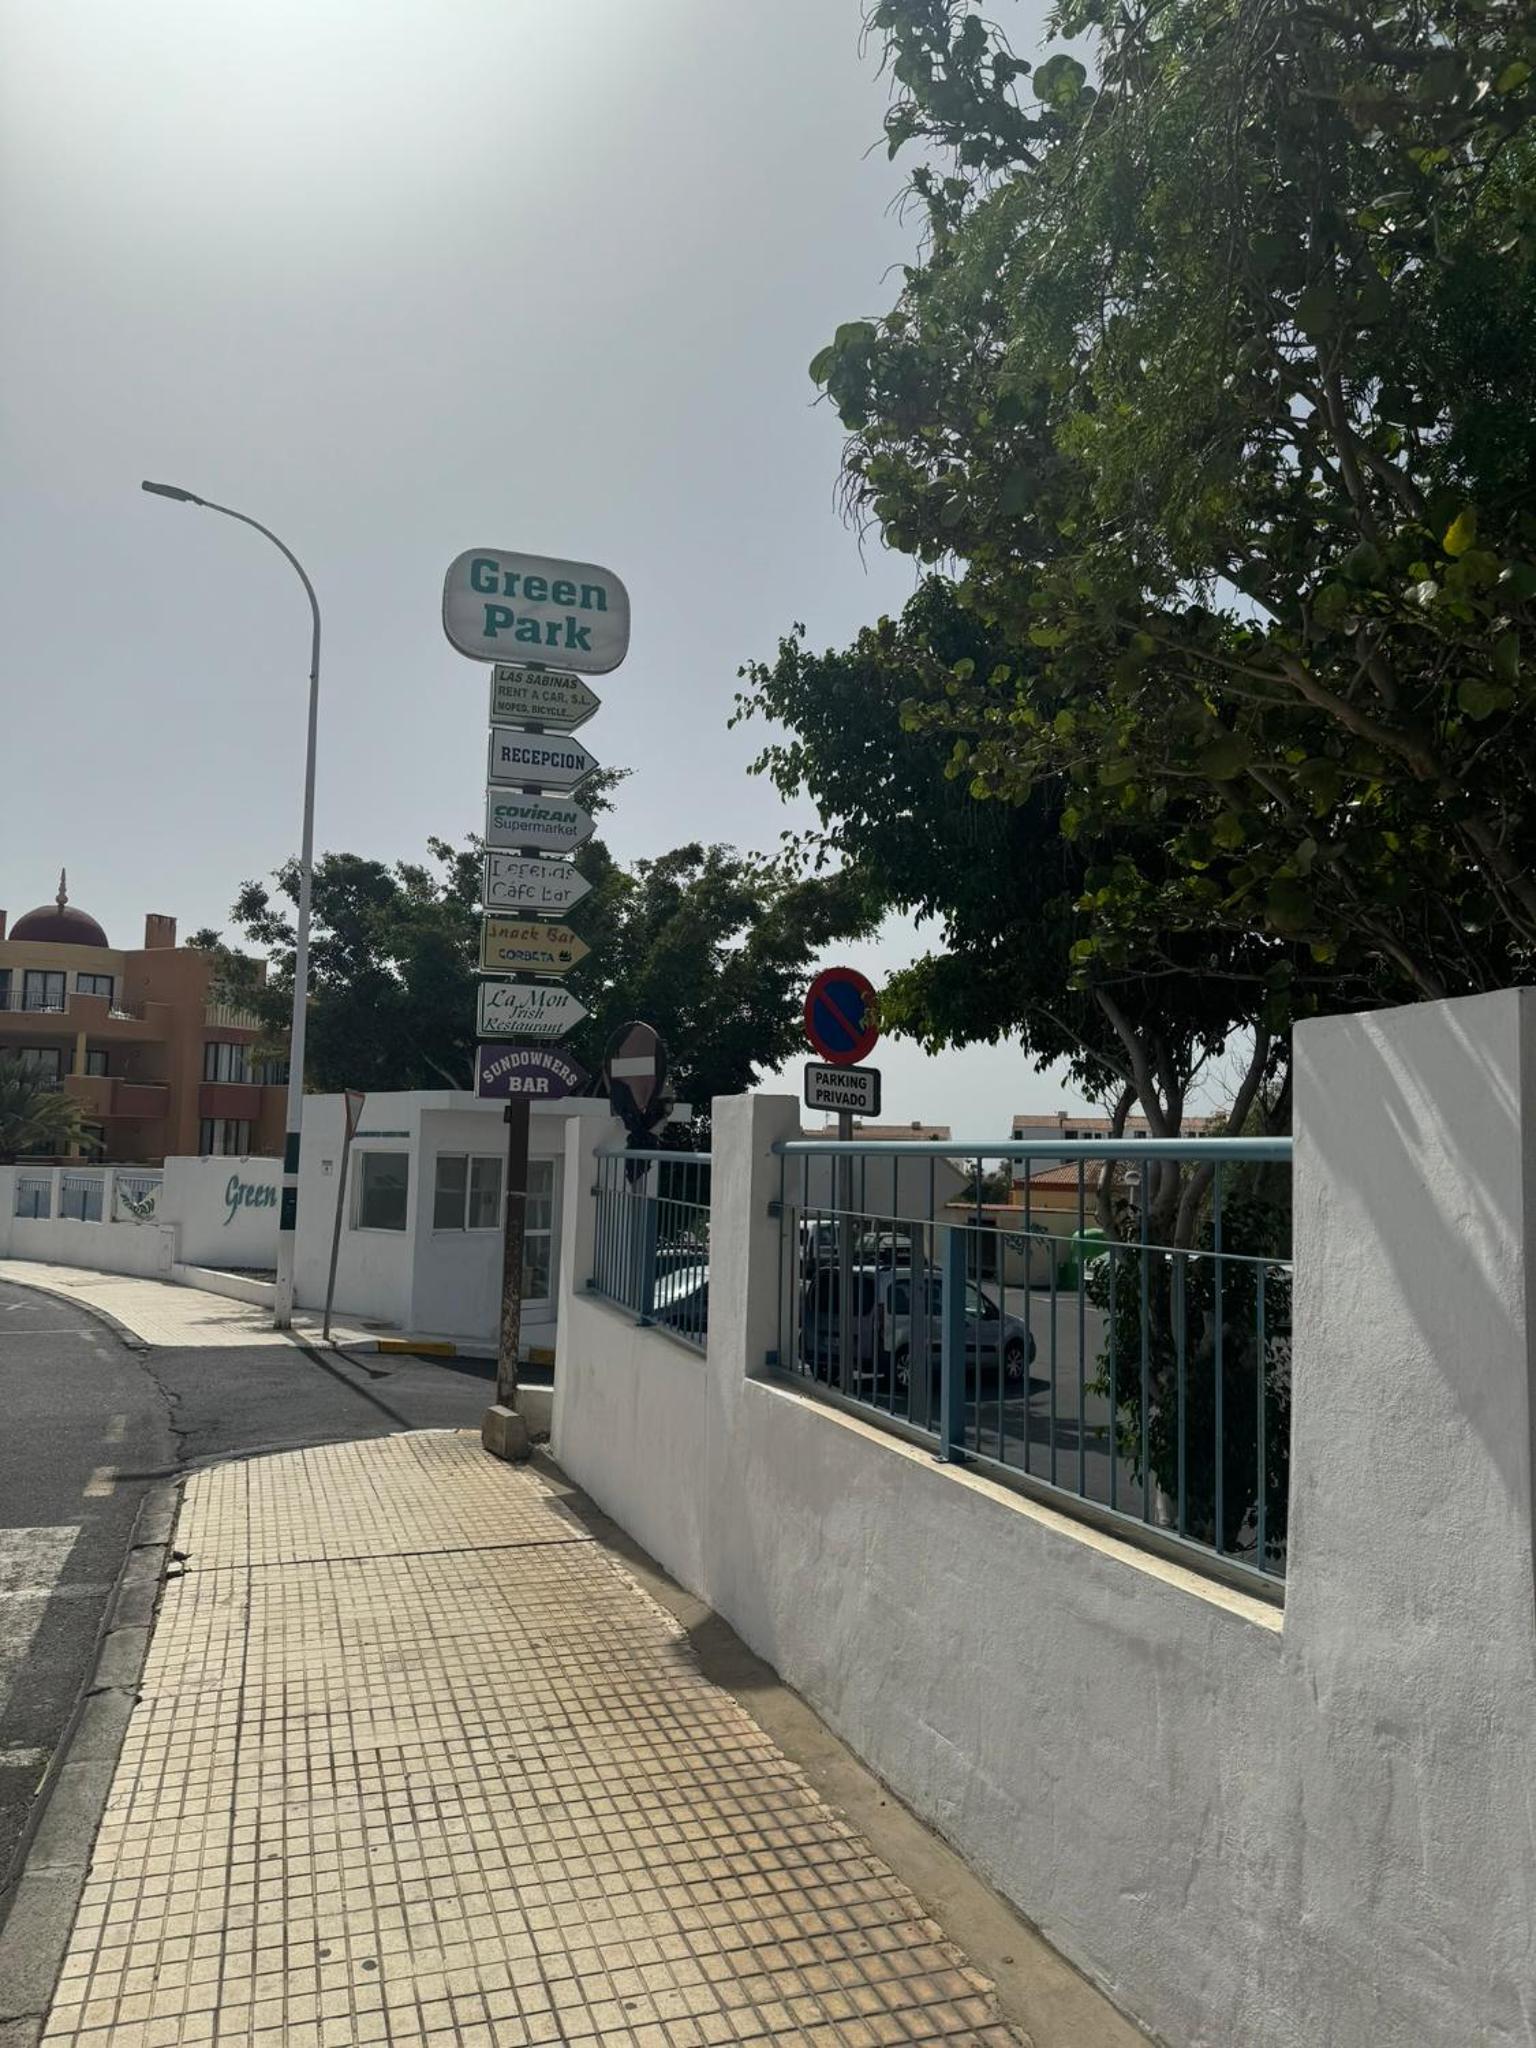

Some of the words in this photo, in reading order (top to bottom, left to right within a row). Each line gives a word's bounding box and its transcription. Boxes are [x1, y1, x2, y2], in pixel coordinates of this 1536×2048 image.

[471, 558, 608, 612] Green
[483, 603, 592, 652] Park
[499, 670, 523, 682] LAS
[525, 673, 578, 689] SABINAS
[497, 686, 528, 698] RENT
[531, 690, 539, 700] A
[570, 694, 591, 705] S.L.
[501, 745, 586, 771] RECEPCION
[494, 816, 577, 836] Supermarket
[546, 927, 575, 944] Bar
[498, 948, 554, 962] CORBETA
[487, 988, 516, 1008] La
[520, 989, 569, 1008] Mon
[508, 1005, 545, 1020] Irish
[484, 1017, 564, 1034] Restaurant
[482, 1050, 578, 1088] SUNDOWNERS
[509, 1076, 549, 1093] BAR
[815, 1071, 868, 1090] PARKING
[815, 1089, 867, 1107] PRIVADO
[223, 1173, 278, 1226] Green
